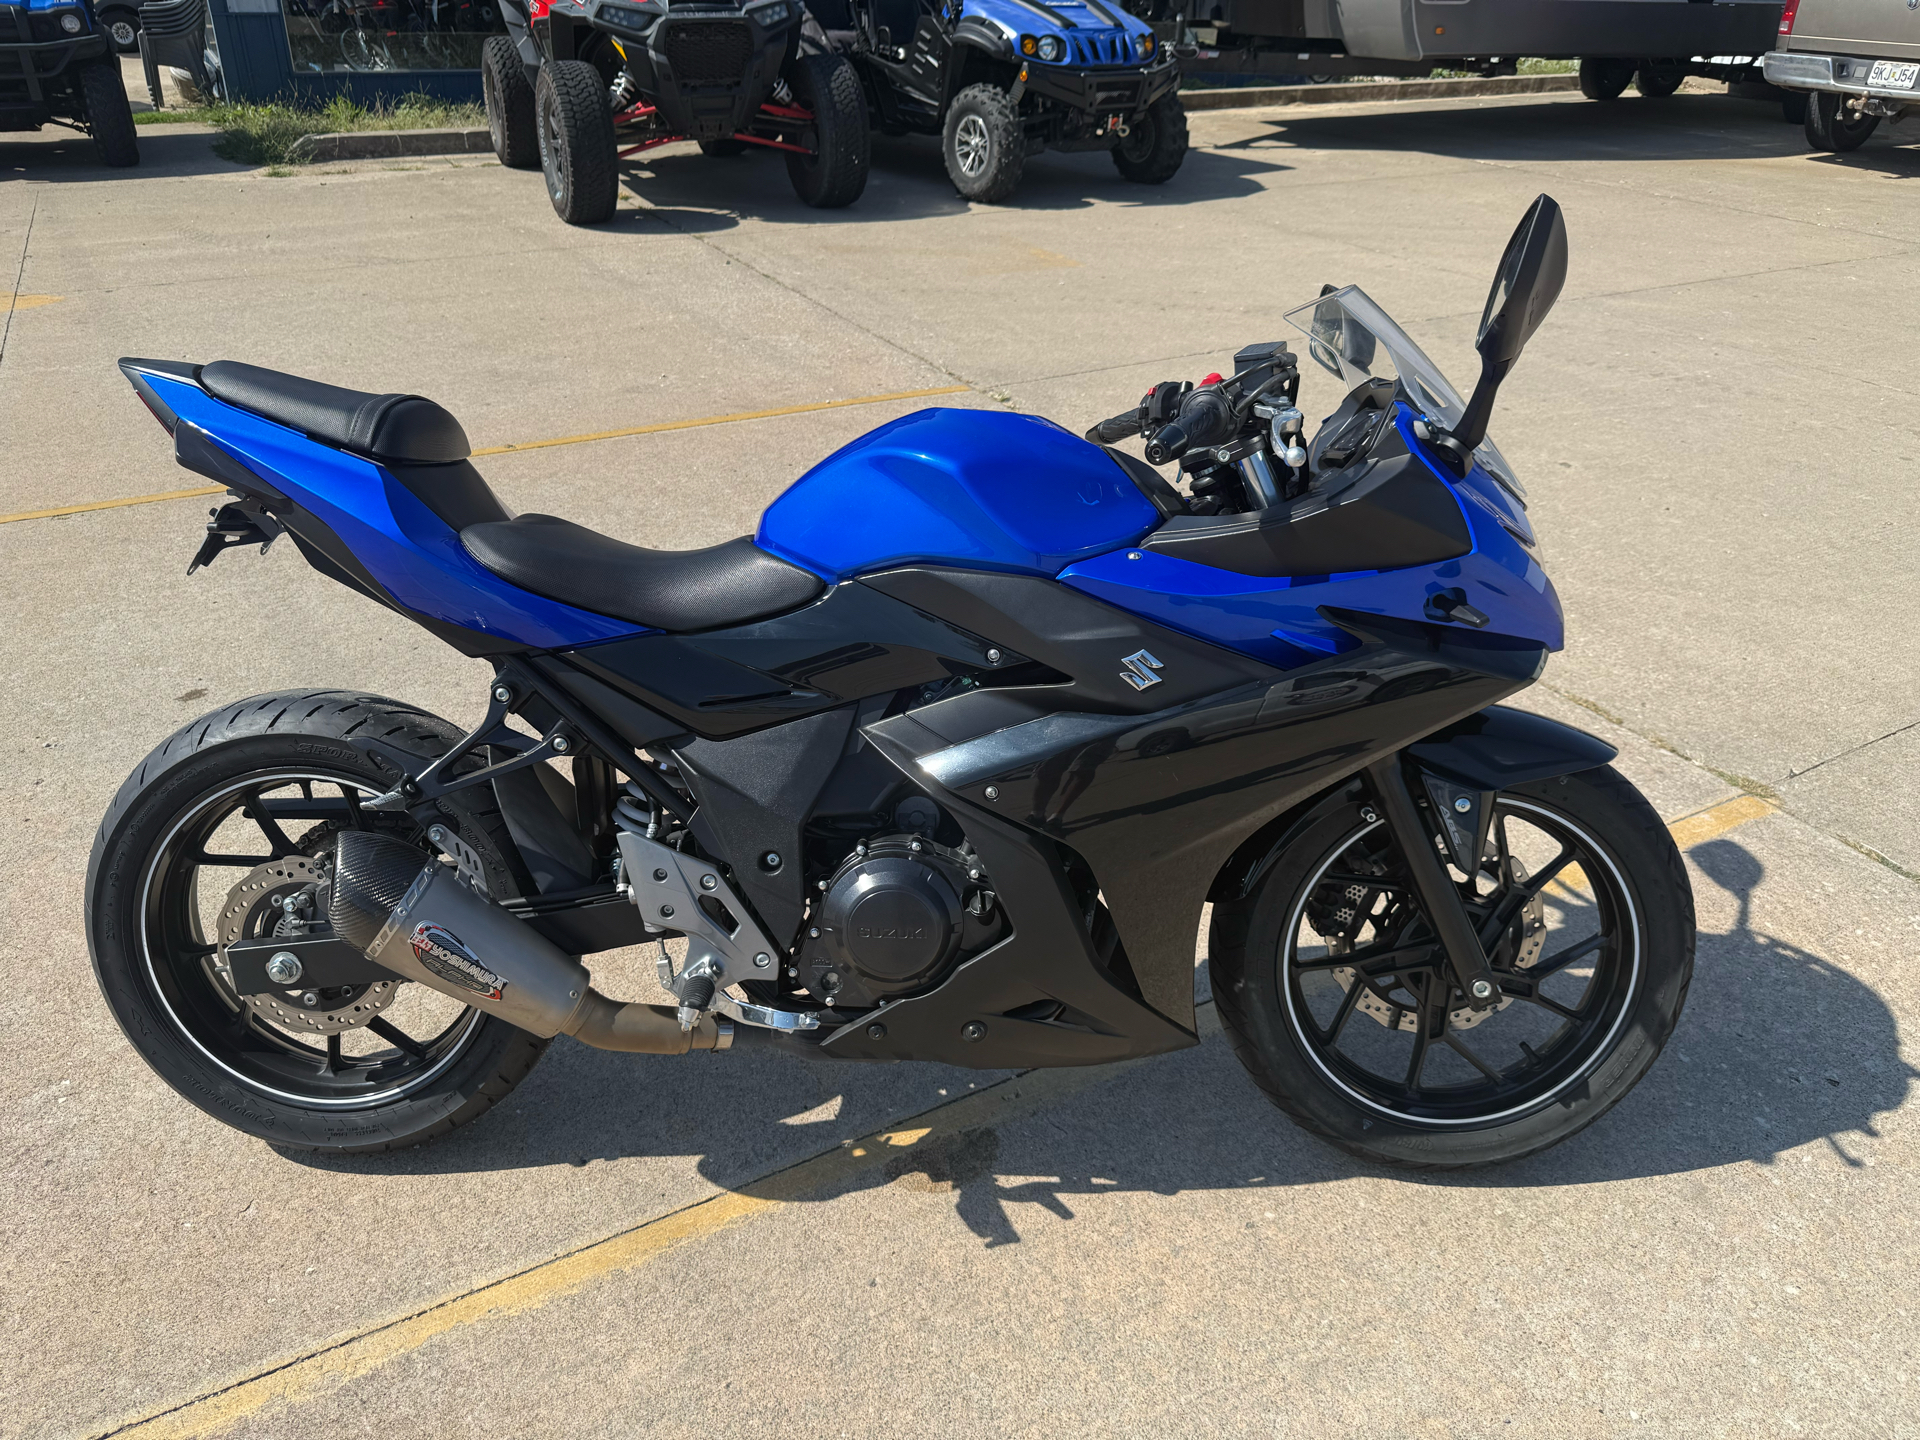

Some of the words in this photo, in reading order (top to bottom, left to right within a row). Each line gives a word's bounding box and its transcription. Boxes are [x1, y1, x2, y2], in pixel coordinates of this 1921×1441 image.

[1871, 66, 1893, 82] 9KJ
[1894, 68, 1916, 83] J54
[857, 927, 928, 939] SUZUKI
[430, 944, 504, 990] YOSHIMURA
